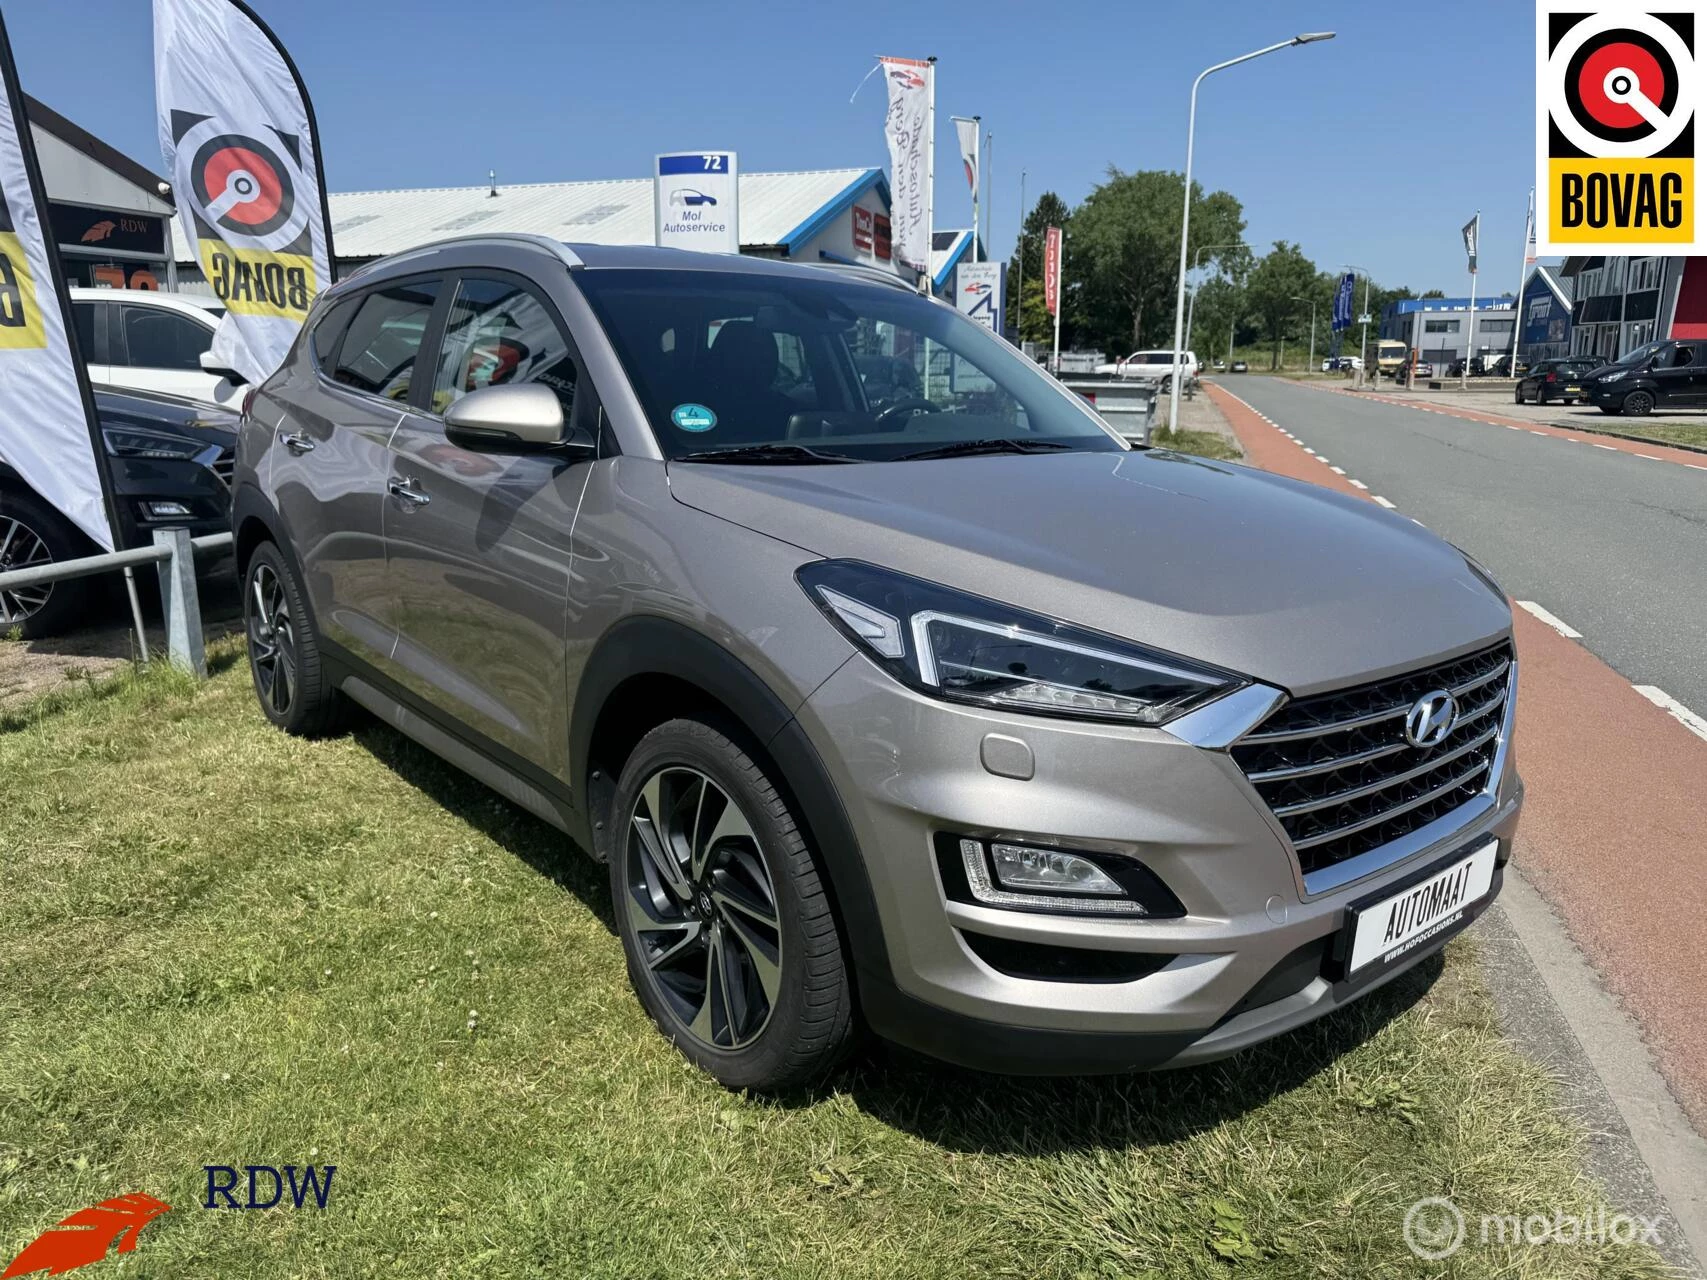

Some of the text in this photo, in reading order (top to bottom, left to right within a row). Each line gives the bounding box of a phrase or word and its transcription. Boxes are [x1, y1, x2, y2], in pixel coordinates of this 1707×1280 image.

[702, 155, 722, 170] 72
[682, 210, 702, 221] Mol
[120, 219, 148, 233] RDW
[663, 222, 726, 233] Autoservice
[688, 407, 699, 418] 4
[1383, 861, 1473, 943] AUTOMAAT
